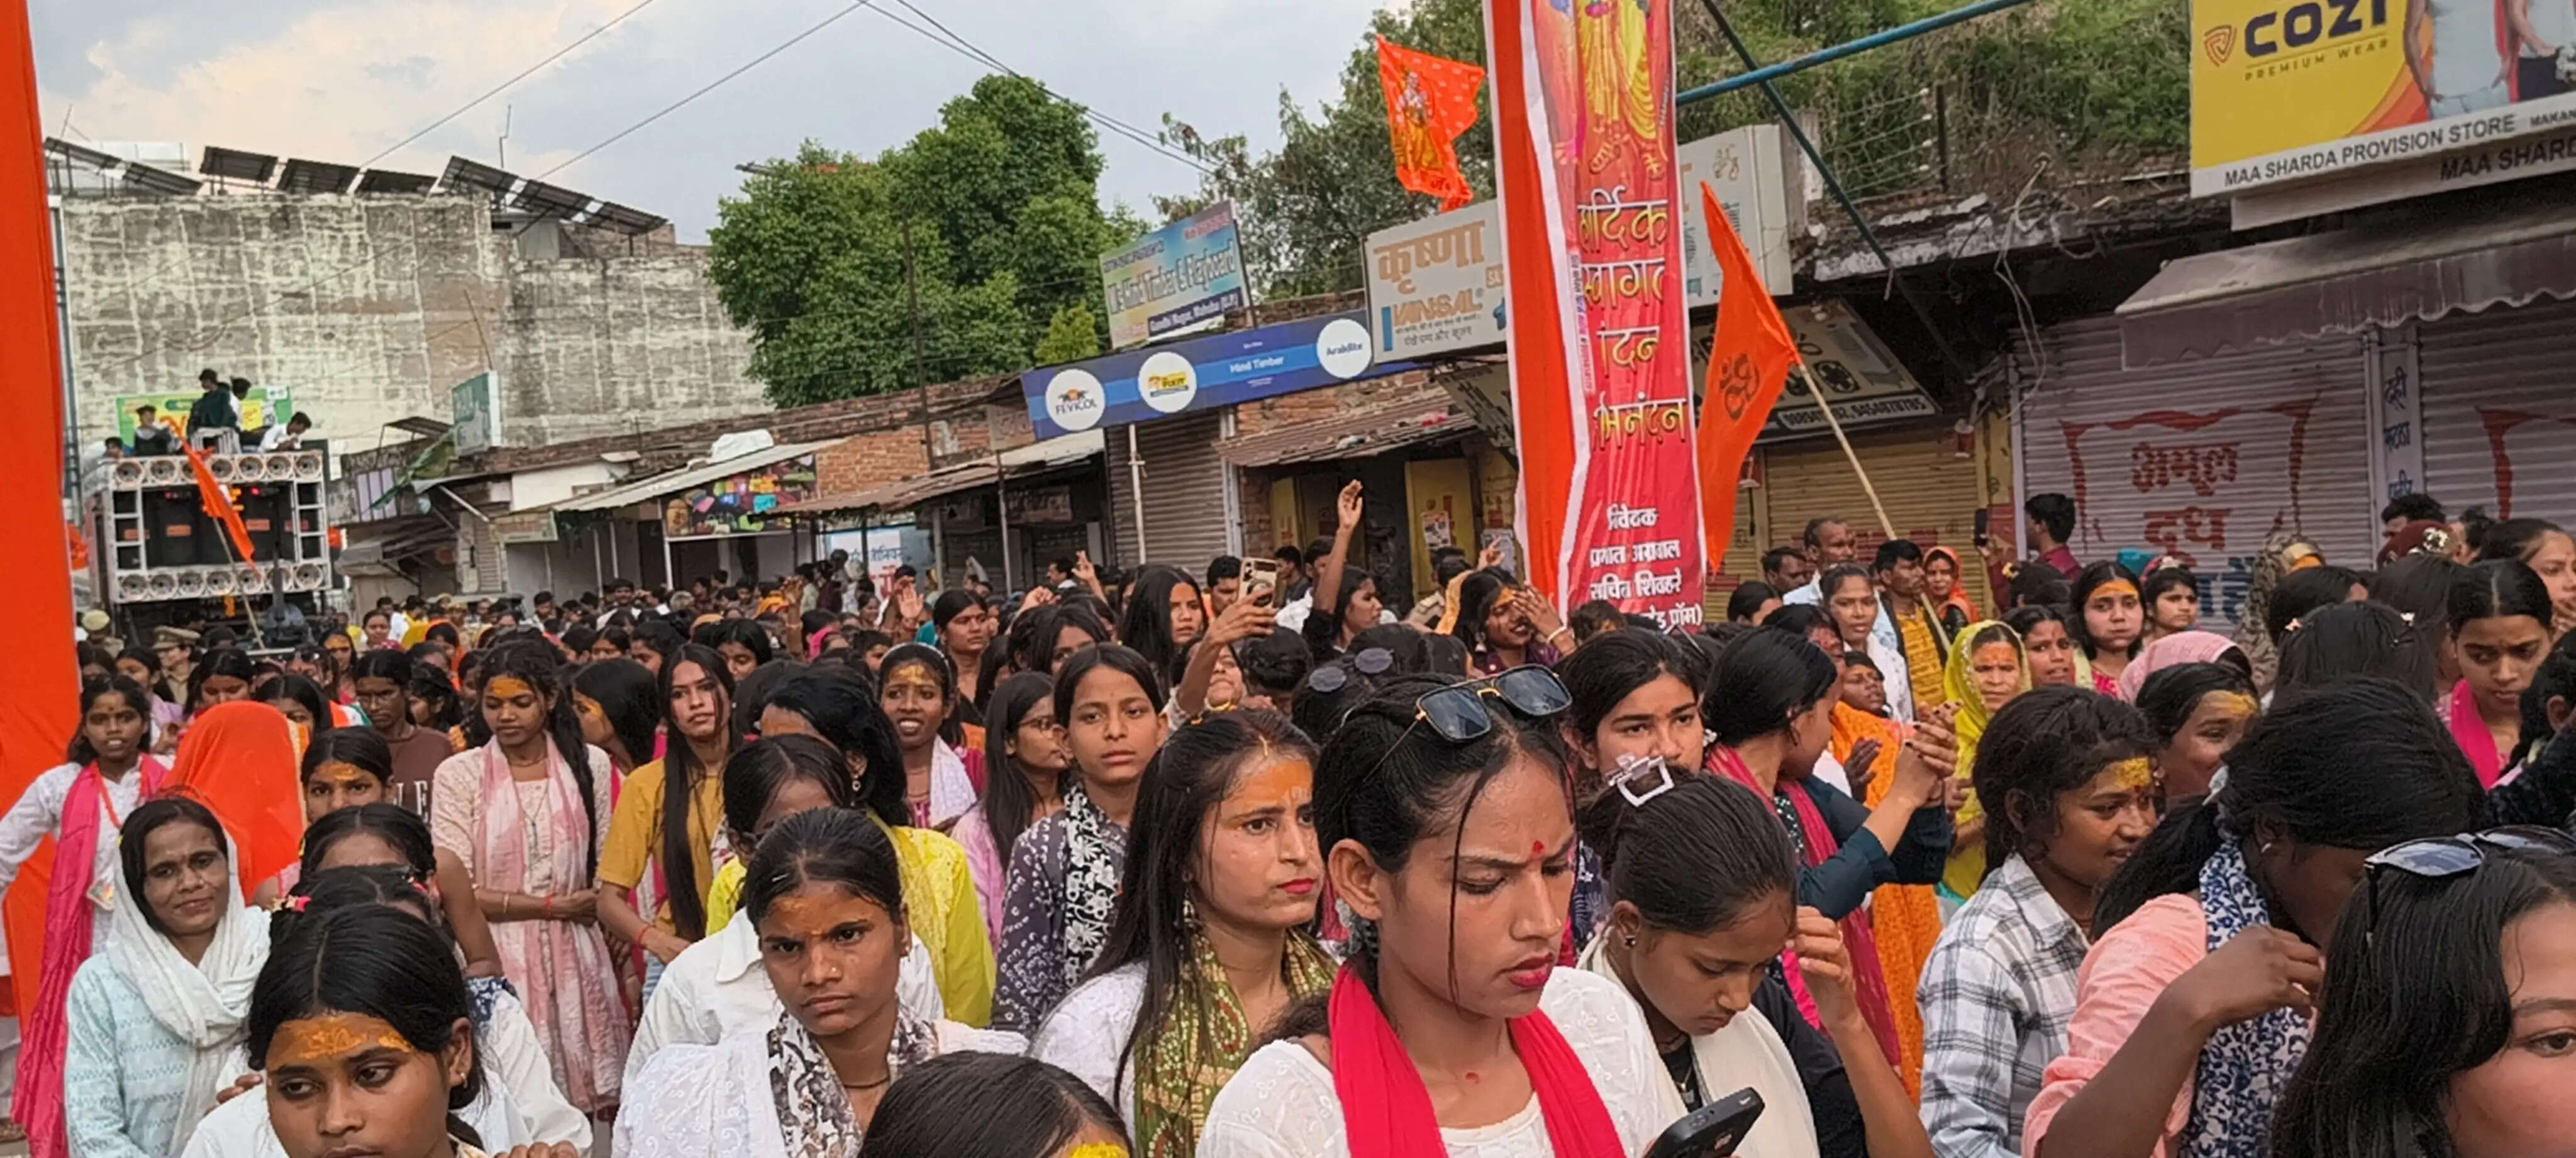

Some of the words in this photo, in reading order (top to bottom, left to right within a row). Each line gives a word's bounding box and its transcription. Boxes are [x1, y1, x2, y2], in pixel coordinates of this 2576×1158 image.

[2245, 0, 2386, 58] COZI
[2245, 55, 2325, 81] PREMIUM
[2338, 38, 2388, 60] WEAR
[2224, 166, 2261, 187] MAA
[2265, 152, 2338, 179] SHARDA
[2342, 129, 2444, 163] PROVISION
[2448, 114, 2515, 143] STORE
[2441, 153, 2492, 181] MAA
[1374, 220, 1485, 295] कृष्णा
[1252, 356, 1285, 370] Timber
[1055, 398, 1097, 416] FEVICOL
[2131, 442, 2241, 497] अमूल
[2143, 506, 2231, 568] दूध
